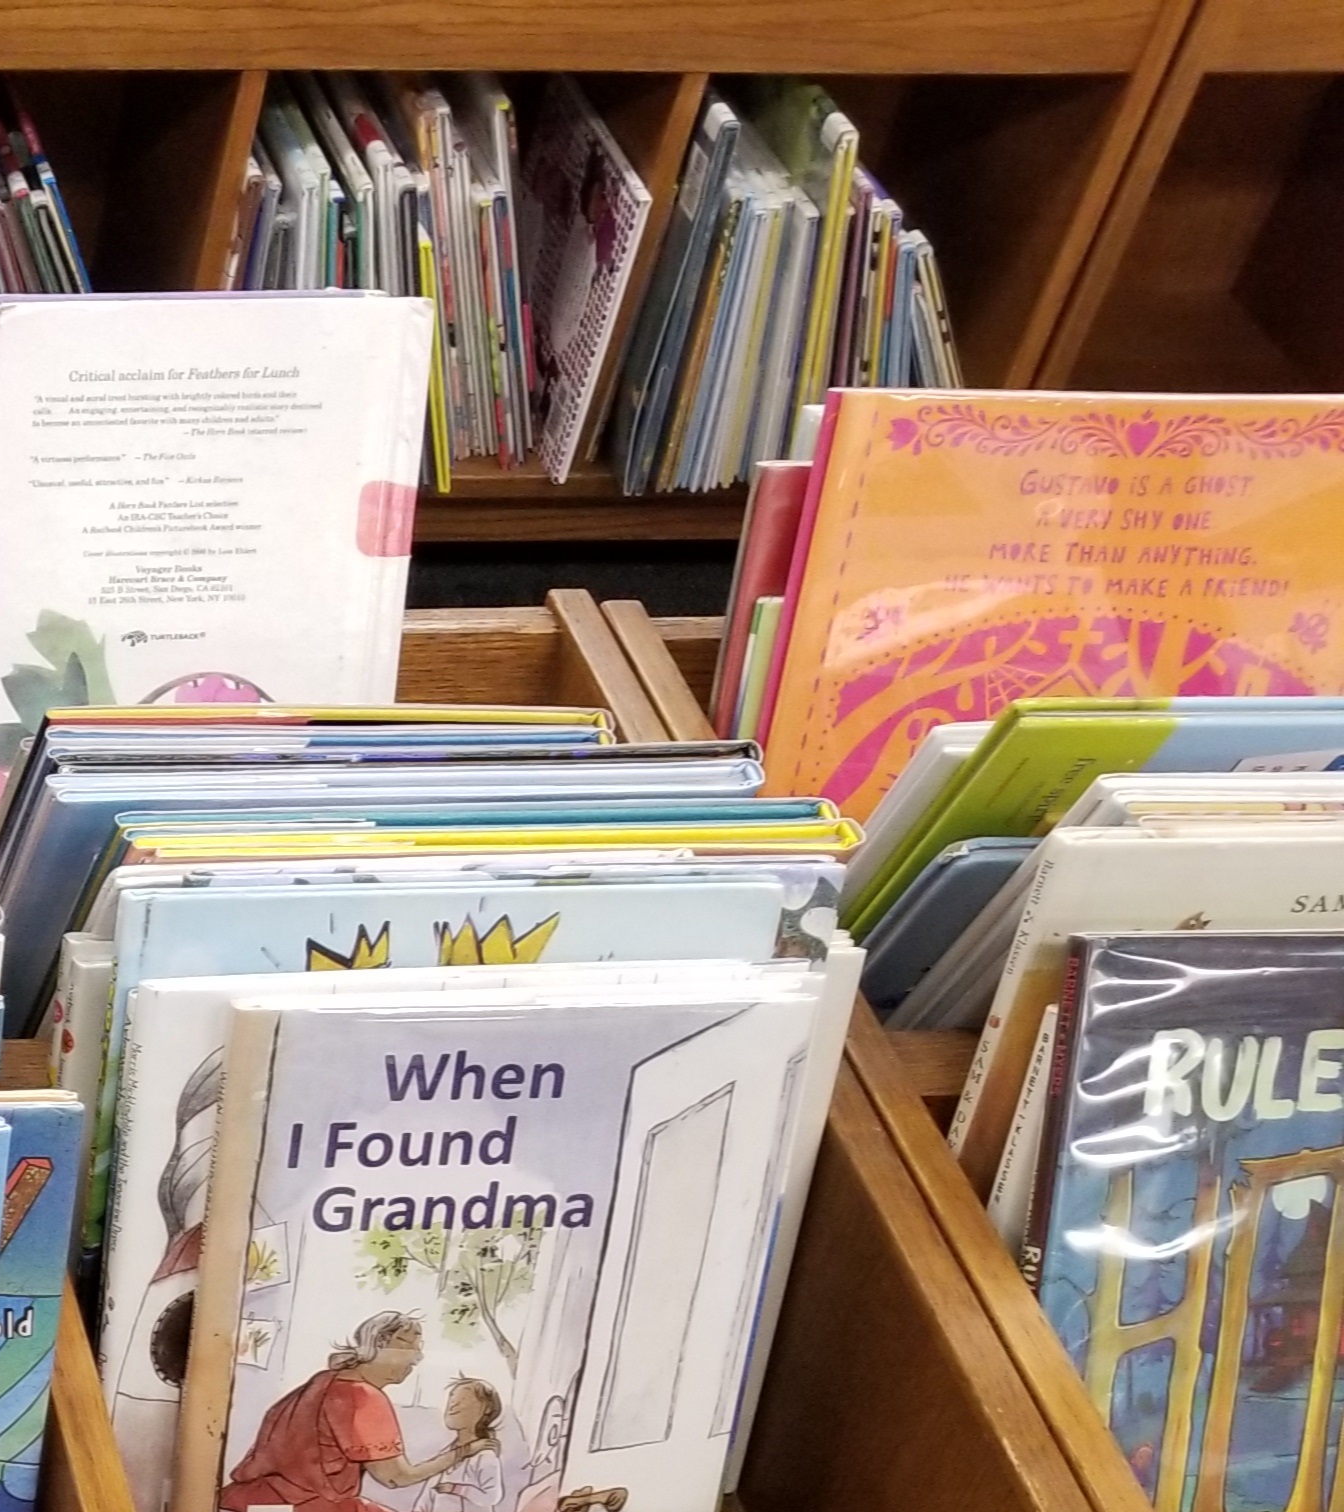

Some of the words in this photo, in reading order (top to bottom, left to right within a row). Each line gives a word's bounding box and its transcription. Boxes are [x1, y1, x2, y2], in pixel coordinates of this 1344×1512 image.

[69, 370, 115, 382] Critical
[119, 370, 164, 382] acclaim
[167, 369, 186, 381] for
[187, 368, 240, 380] Feathers
[241, 367, 260, 380] for
[262, 367, 300, 378] Lunch
[1020, 470, 1120, 496] GUSTAVO
[1162, 476, 1173, 496] A
[1184, 476, 1255, 496] GHOST
[1060, 509, 1113, 530] VERY
[1120, 509, 1163, 530] SHY
[1172, 510, 1212, 530] ONE
[988, 543, 1051, 563] MORE
[1065, 542, 1126, 564] THAN
[983, 575, 1058, 596] WANTS
[1068, 576, 1093, 596] TO
[1105, 579, 1168, 598] MAKE
[1179, 580, 1192, 596] A
[1203, 579, 1290, 598] FRIEND!
[384, 1052, 566, 1101] When
[971, 1039, 991, 1086] SAM
[1018, 1033, 1050, 1114] BARNETT
[1142, 1027, 1344, 1121] RULE
[287, 1123, 303, 1170] I
[323, 1115, 518, 1169] Found
[994, 1126, 1023, 1204] KLASSEN
[312, 1182, 594, 1233] Grandma
